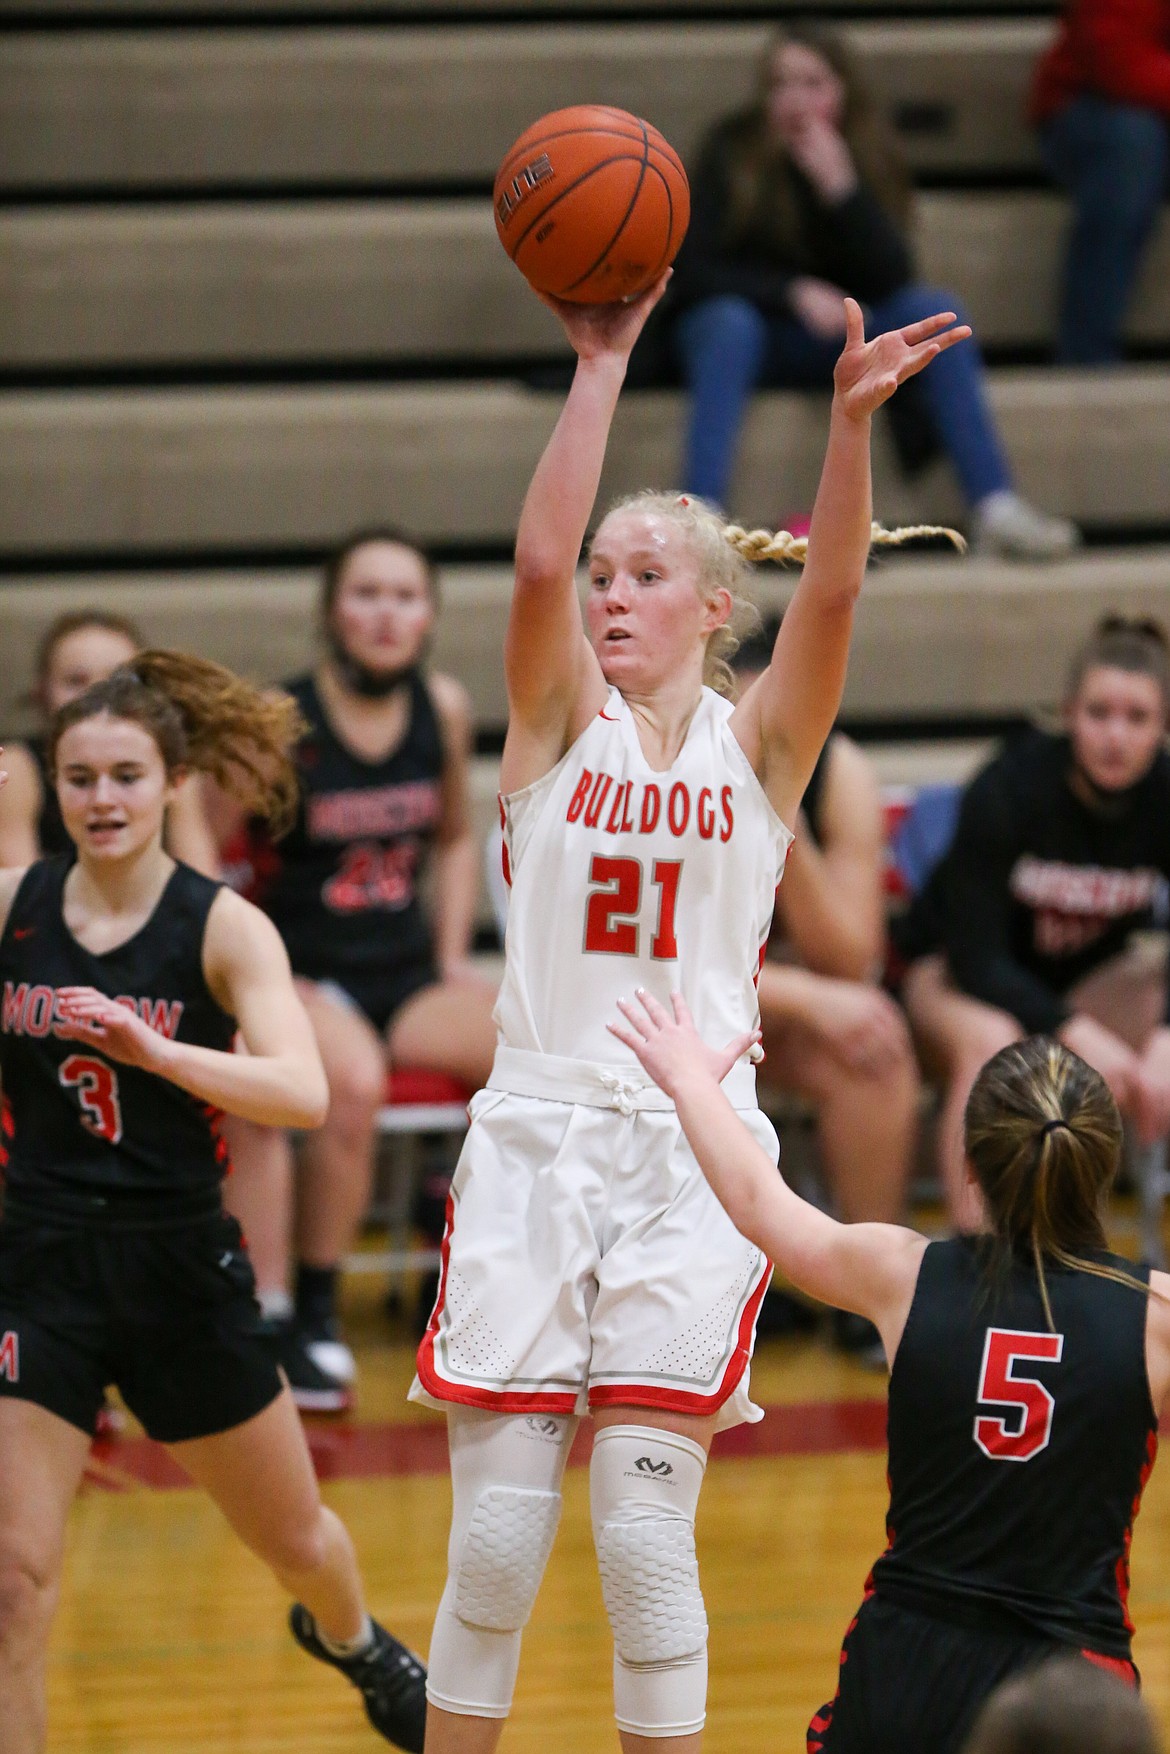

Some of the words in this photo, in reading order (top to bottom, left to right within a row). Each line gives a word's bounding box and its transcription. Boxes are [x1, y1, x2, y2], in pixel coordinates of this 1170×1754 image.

[497, 153, 553, 225] ELITE
[566, 767, 734, 843] BULLDOGS
[581, 851, 685, 962] 21
[58, 1054, 122, 1144] 3
[973, 1327, 1064, 1462] 5
